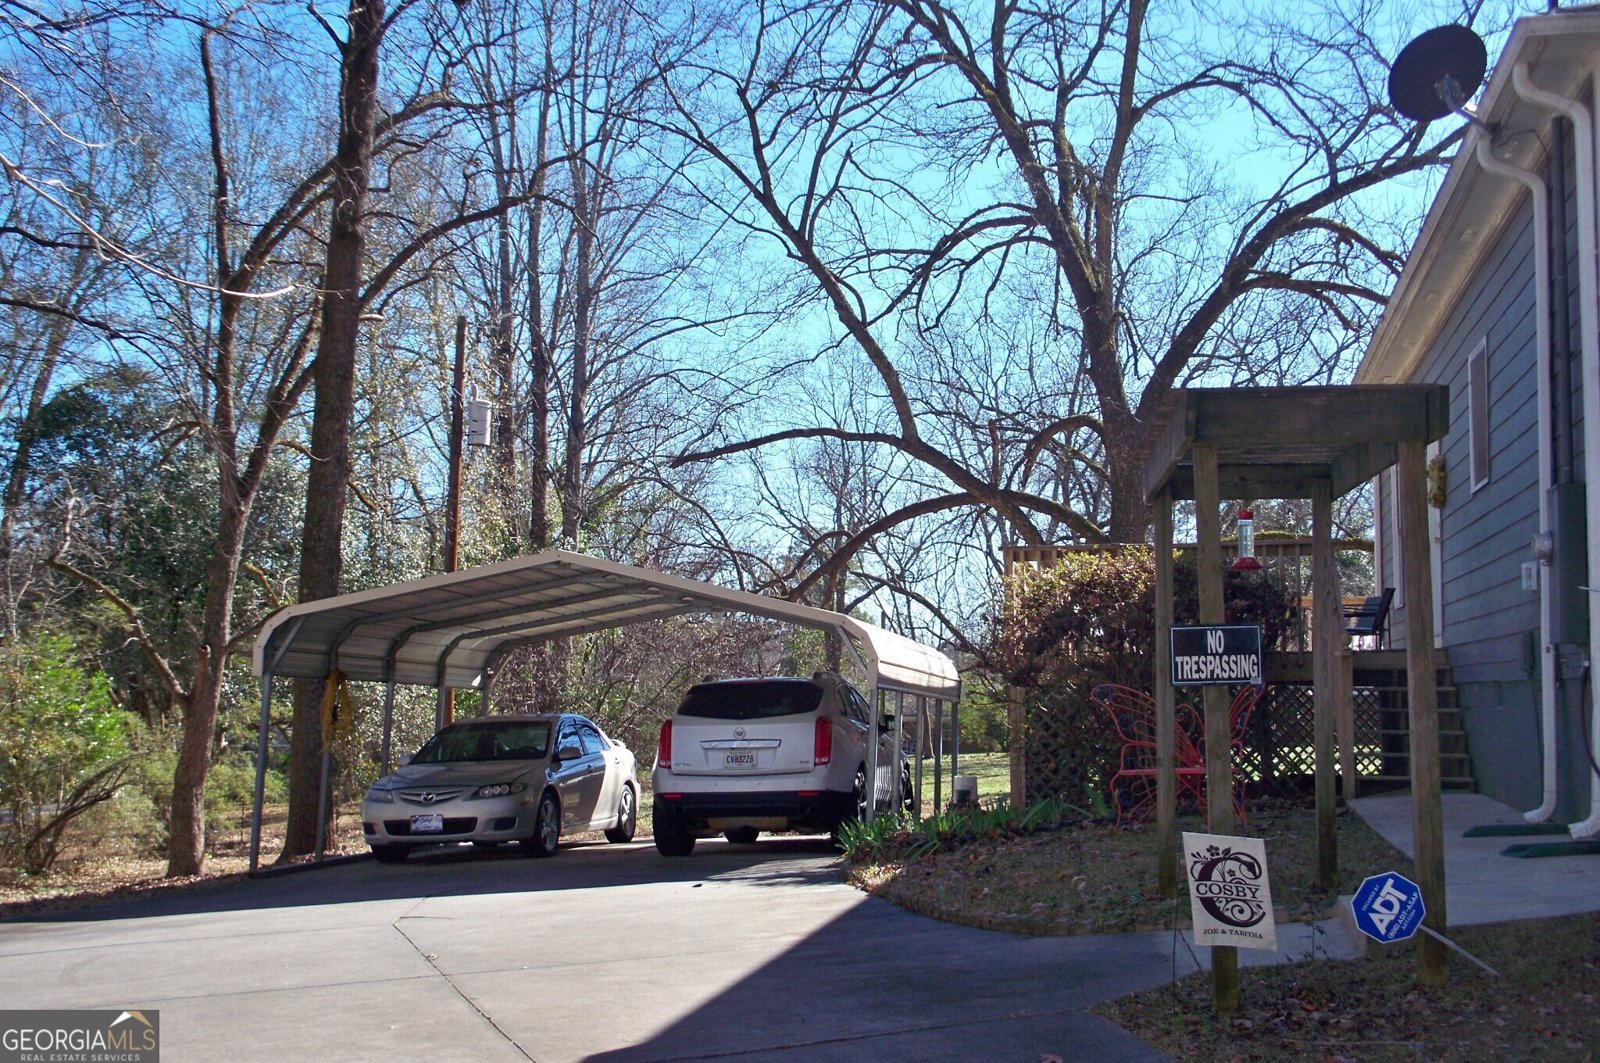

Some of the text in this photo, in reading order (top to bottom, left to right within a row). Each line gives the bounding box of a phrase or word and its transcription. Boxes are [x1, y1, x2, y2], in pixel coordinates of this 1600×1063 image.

[1207, 630, 1225, 654] NO
[1175, 654, 1258, 679] TRESPASSING
[1196, 883, 1260, 899] COSBY
[1361, 884, 1380, 911] SECURED BY
[1368, 877, 1408, 936] ADT
[1229, 929, 1264, 939] TABITHA
